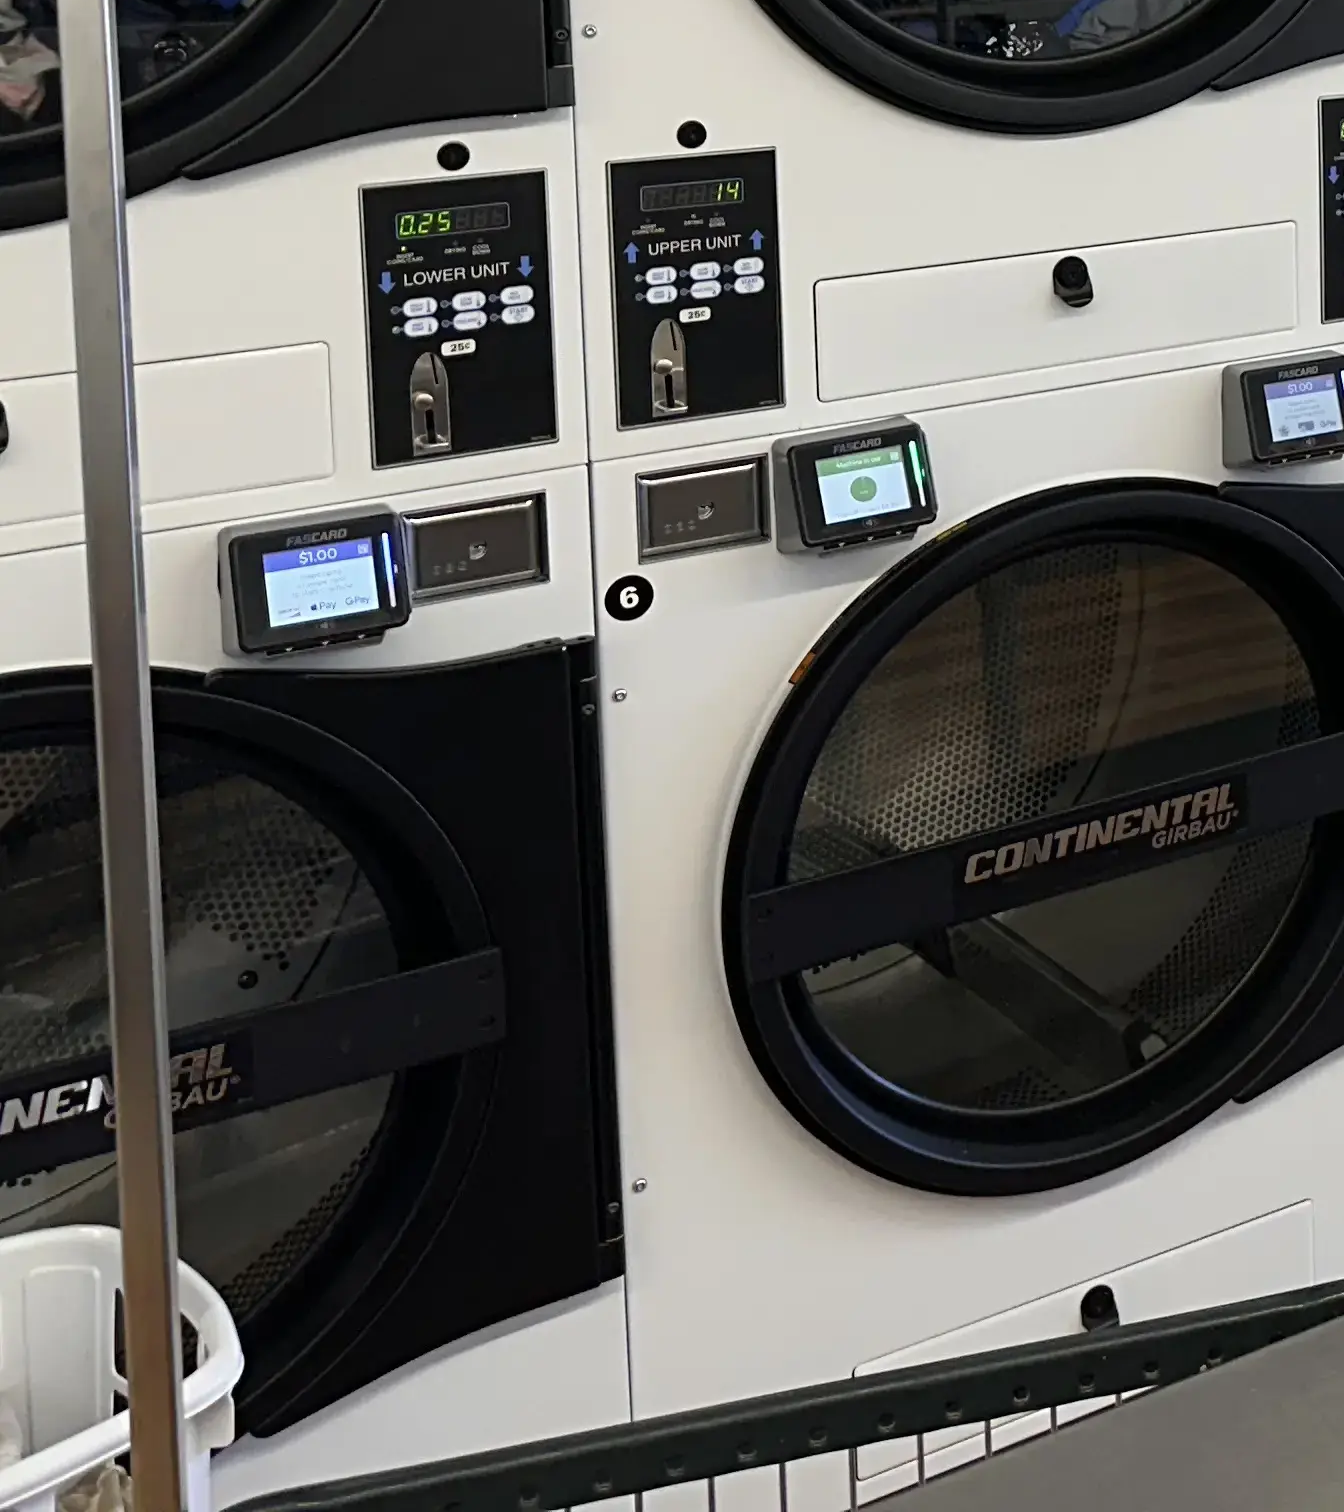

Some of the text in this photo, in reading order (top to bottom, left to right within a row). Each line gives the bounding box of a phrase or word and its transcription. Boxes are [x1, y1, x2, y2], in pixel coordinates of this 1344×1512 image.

[716, 181, 740, 201] 14
[398, 210, 451, 236] 0.25
[648, 234, 742, 257] UPPER UNIT
[403, 261, 511, 287] LOWER UNIT
[1278, 366, 1319, 380] FASCARD
[833, 437, 882, 454] FASCARD
[285, 528, 348, 547] FASCARD
[299, 547, 338, 565] $1.00
[319, 600, 337, 611] Pay
[618, 586, 639, 609] 6
[964, 783, 1234, 884] CONTINENTAL
[1151, 810, 1231, 849] GIRBAU
